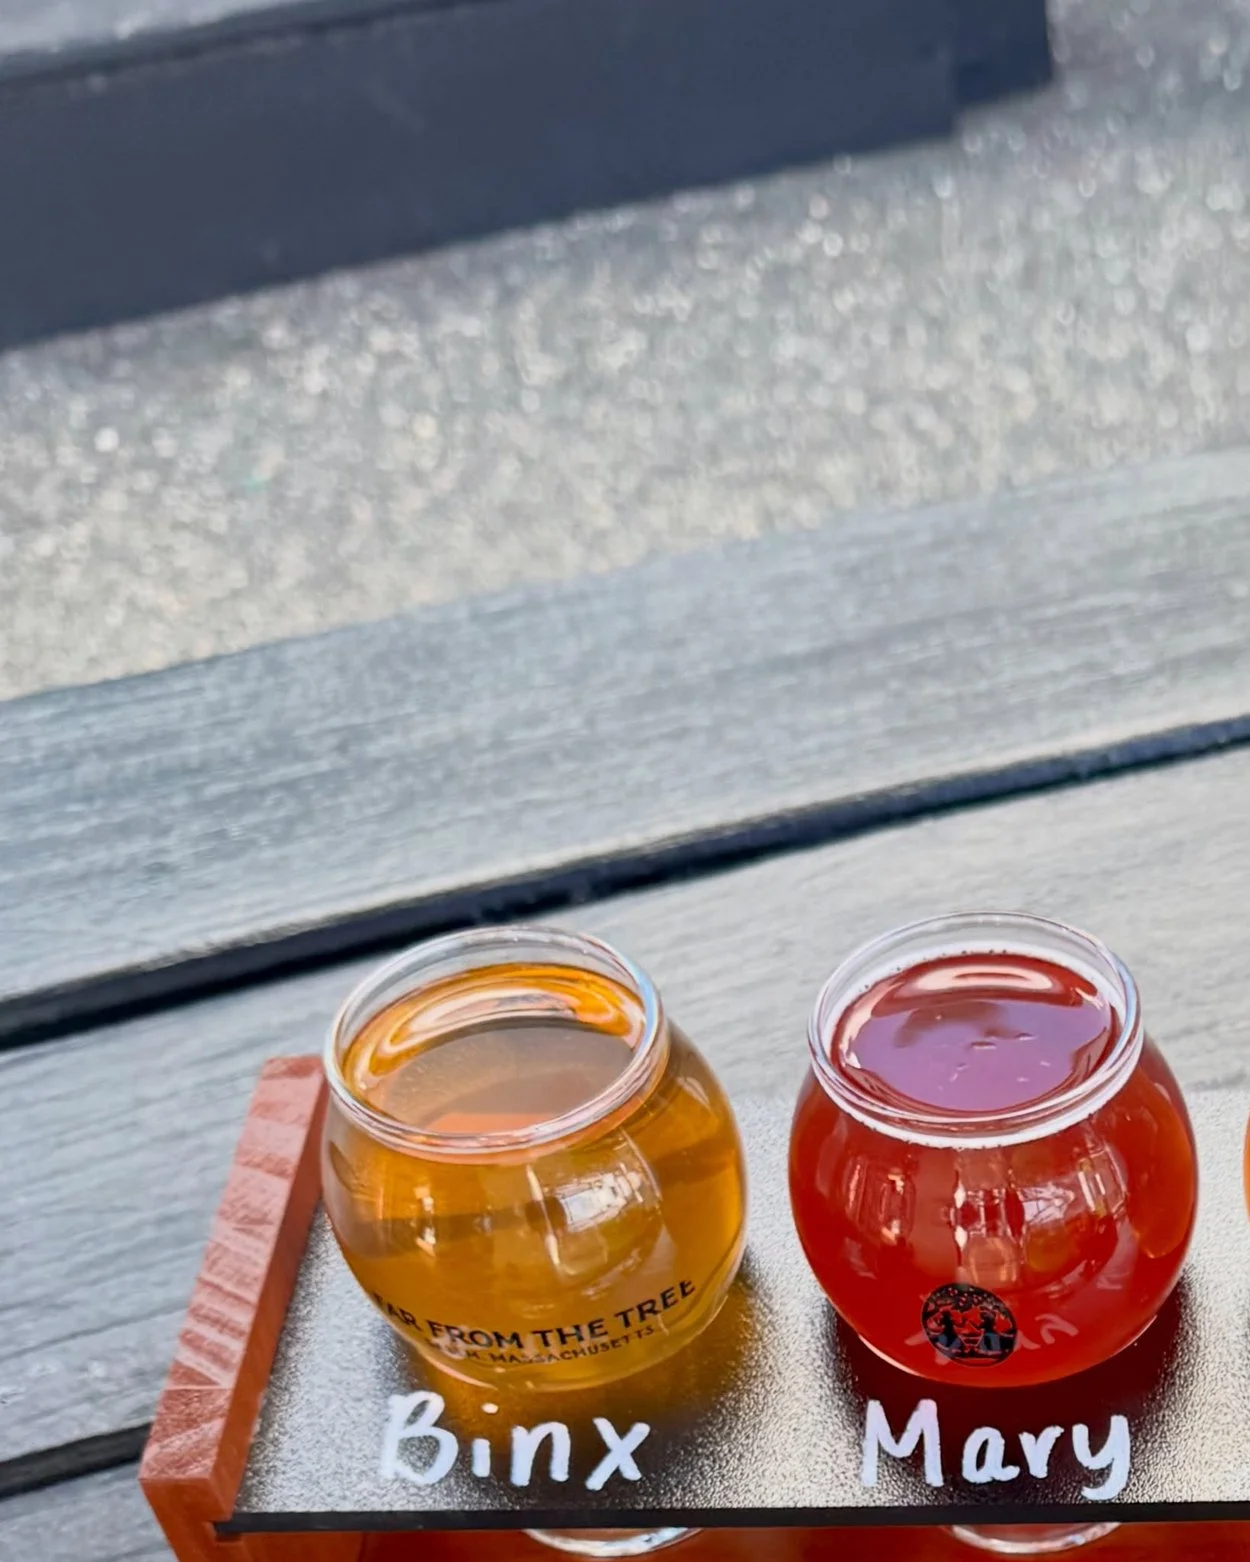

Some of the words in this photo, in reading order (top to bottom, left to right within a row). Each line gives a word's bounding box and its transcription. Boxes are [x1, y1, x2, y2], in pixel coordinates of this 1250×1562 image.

[425, 1319, 524, 1349] FROM
[532, 1317, 609, 1348] THE
[614, 1279, 696, 1329] TREE
[379, 1390, 651, 1491] Binx
[860, 1397, 1132, 1501] Mary
